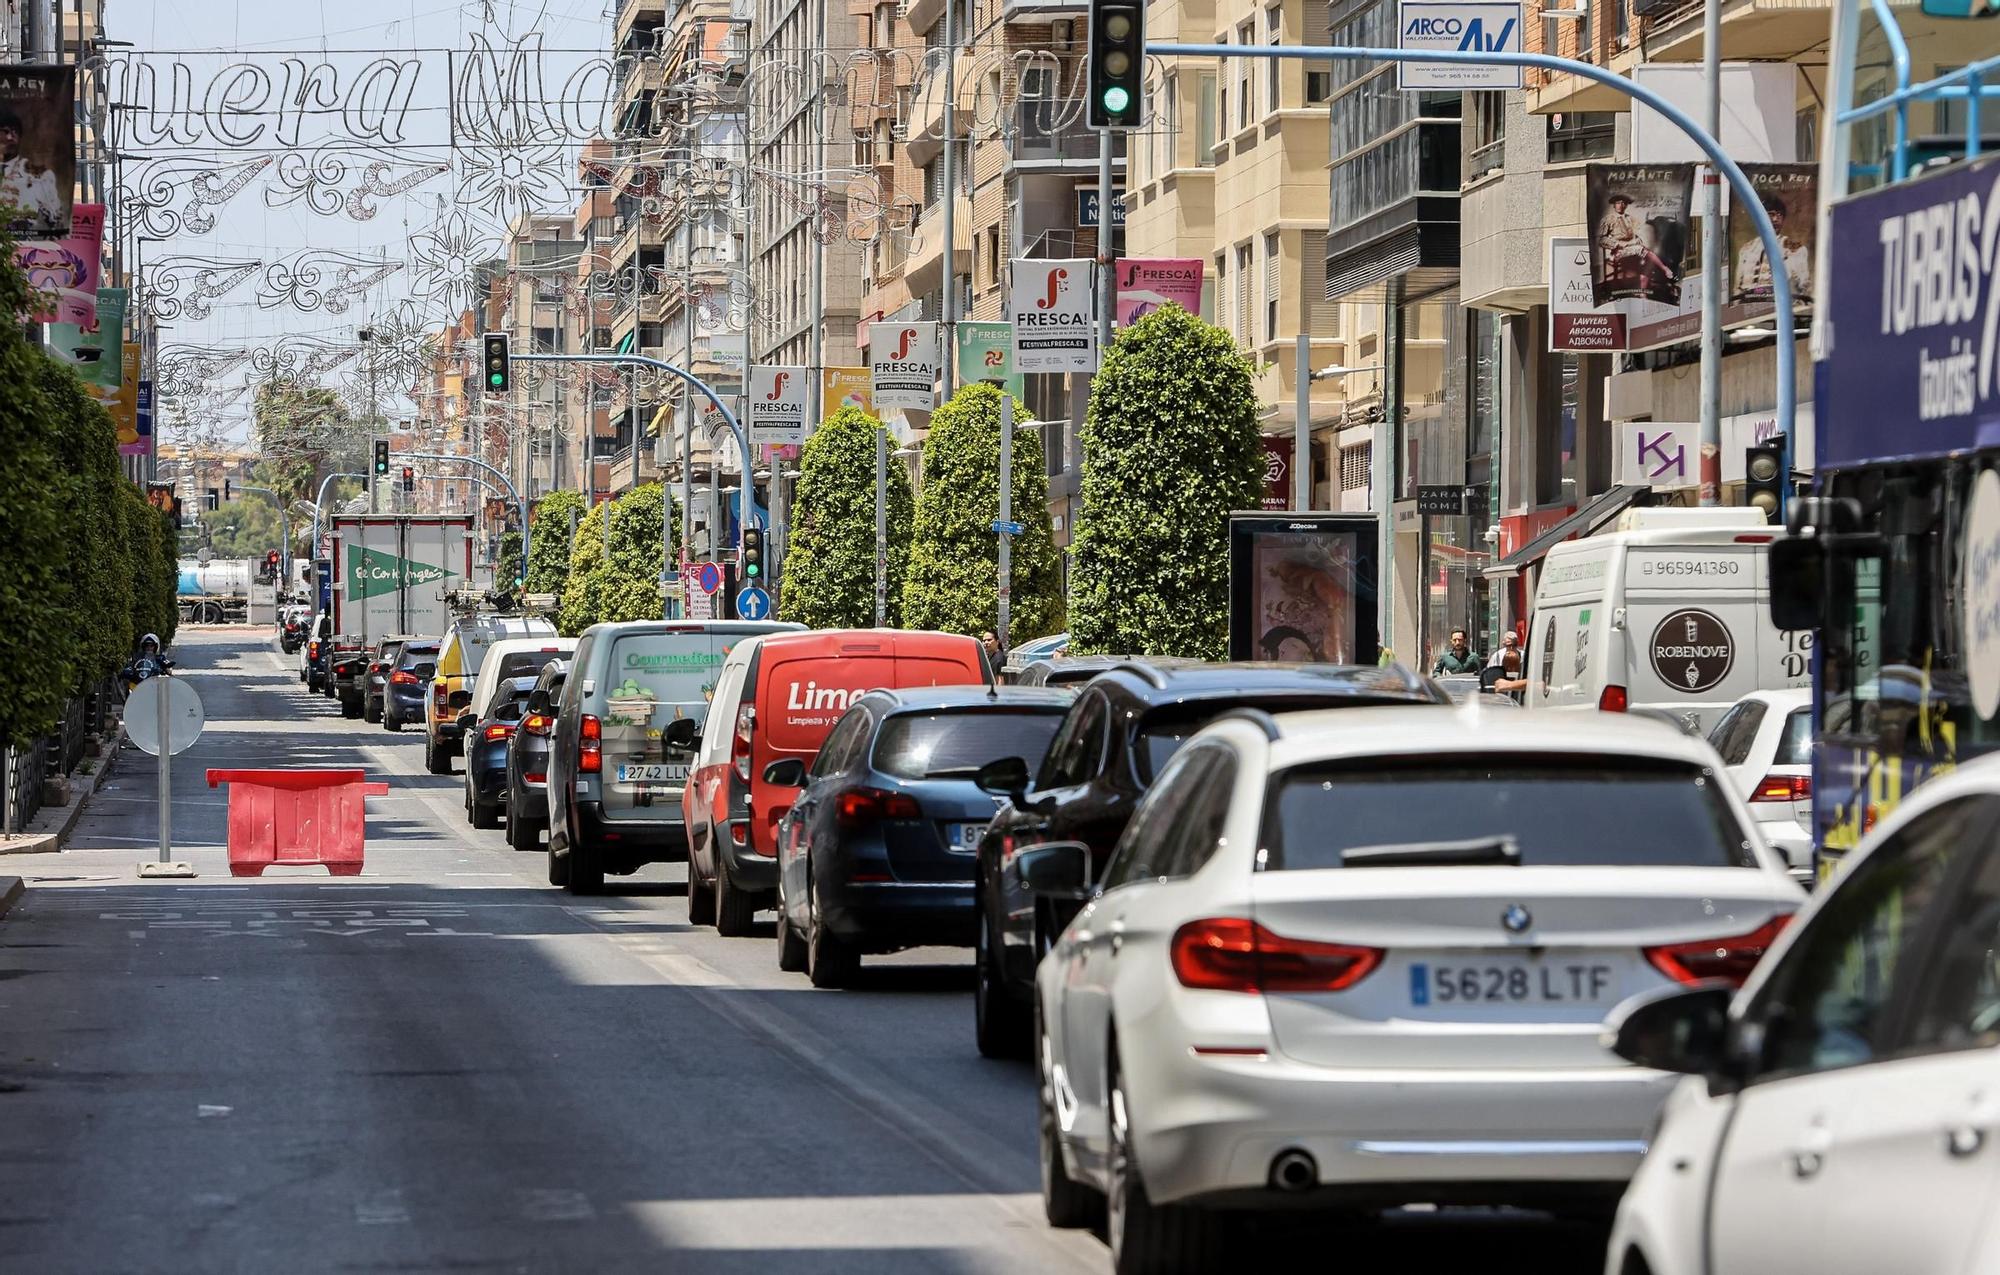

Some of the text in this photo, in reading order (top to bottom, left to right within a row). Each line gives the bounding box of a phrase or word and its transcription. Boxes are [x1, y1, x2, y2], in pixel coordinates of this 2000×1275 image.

[1405, 18, 1462, 35] ARCO
[18, 77, 45, 91] REY
[1608, 169, 1673, 183] MORANTE
[1789, 174, 1810, 184] REY
[1143, 270, 1196, 279] FRESCA!
[1017, 313, 1087, 326] FRESCA!
[1573, 317, 1608, 325] LAWYERS
[875, 362, 932, 373] FRESCA!
[753, 403, 801, 412] FRESCA!
[1656, 561, 1739, 574] 965941380
[1656, 646, 1728, 659] ROBENOVE
[787, 716, 823, 726] Limpieza
[824, 718, 831, 726] y
[628, 767, 691, 779] 2742 LLN
[1435, 965, 1611, 1001] 5628 LTF
